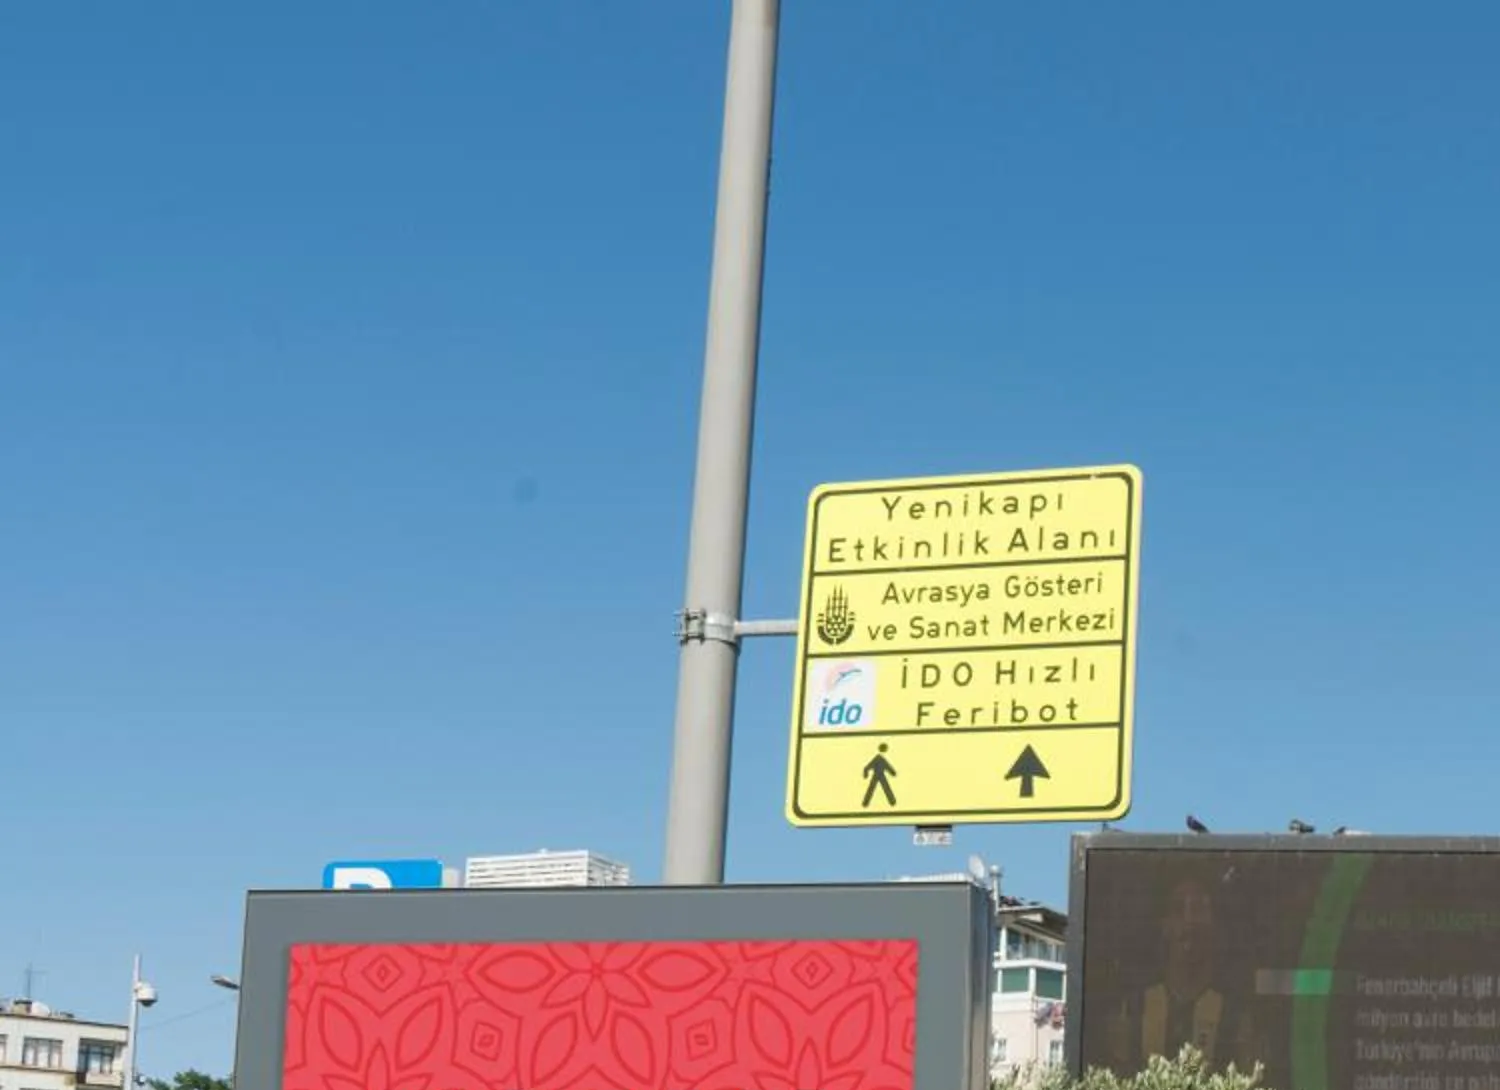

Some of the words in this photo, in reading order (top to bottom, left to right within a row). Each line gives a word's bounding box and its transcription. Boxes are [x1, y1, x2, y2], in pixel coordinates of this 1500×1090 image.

[881, 491, 1063, 520] Yenikapı
[829, 529, 990, 563] Etkinlik
[1007, 526, 1116, 553] Alanı
[881, 581, 991, 608] Avrasya
[1004, 571, 1103, 598] Gösteri
[867, 622, 898, 641] ve
[908, 614, 991, 640] Sanat
[1002, 607, 1116, 635] Merkezi
[901, 657, 974, 689] İDO
[995, 657, 1095, 685] Hızlı
[818, 699, 862, 726] ido
[916, 698, 1079, 727] Feribot
